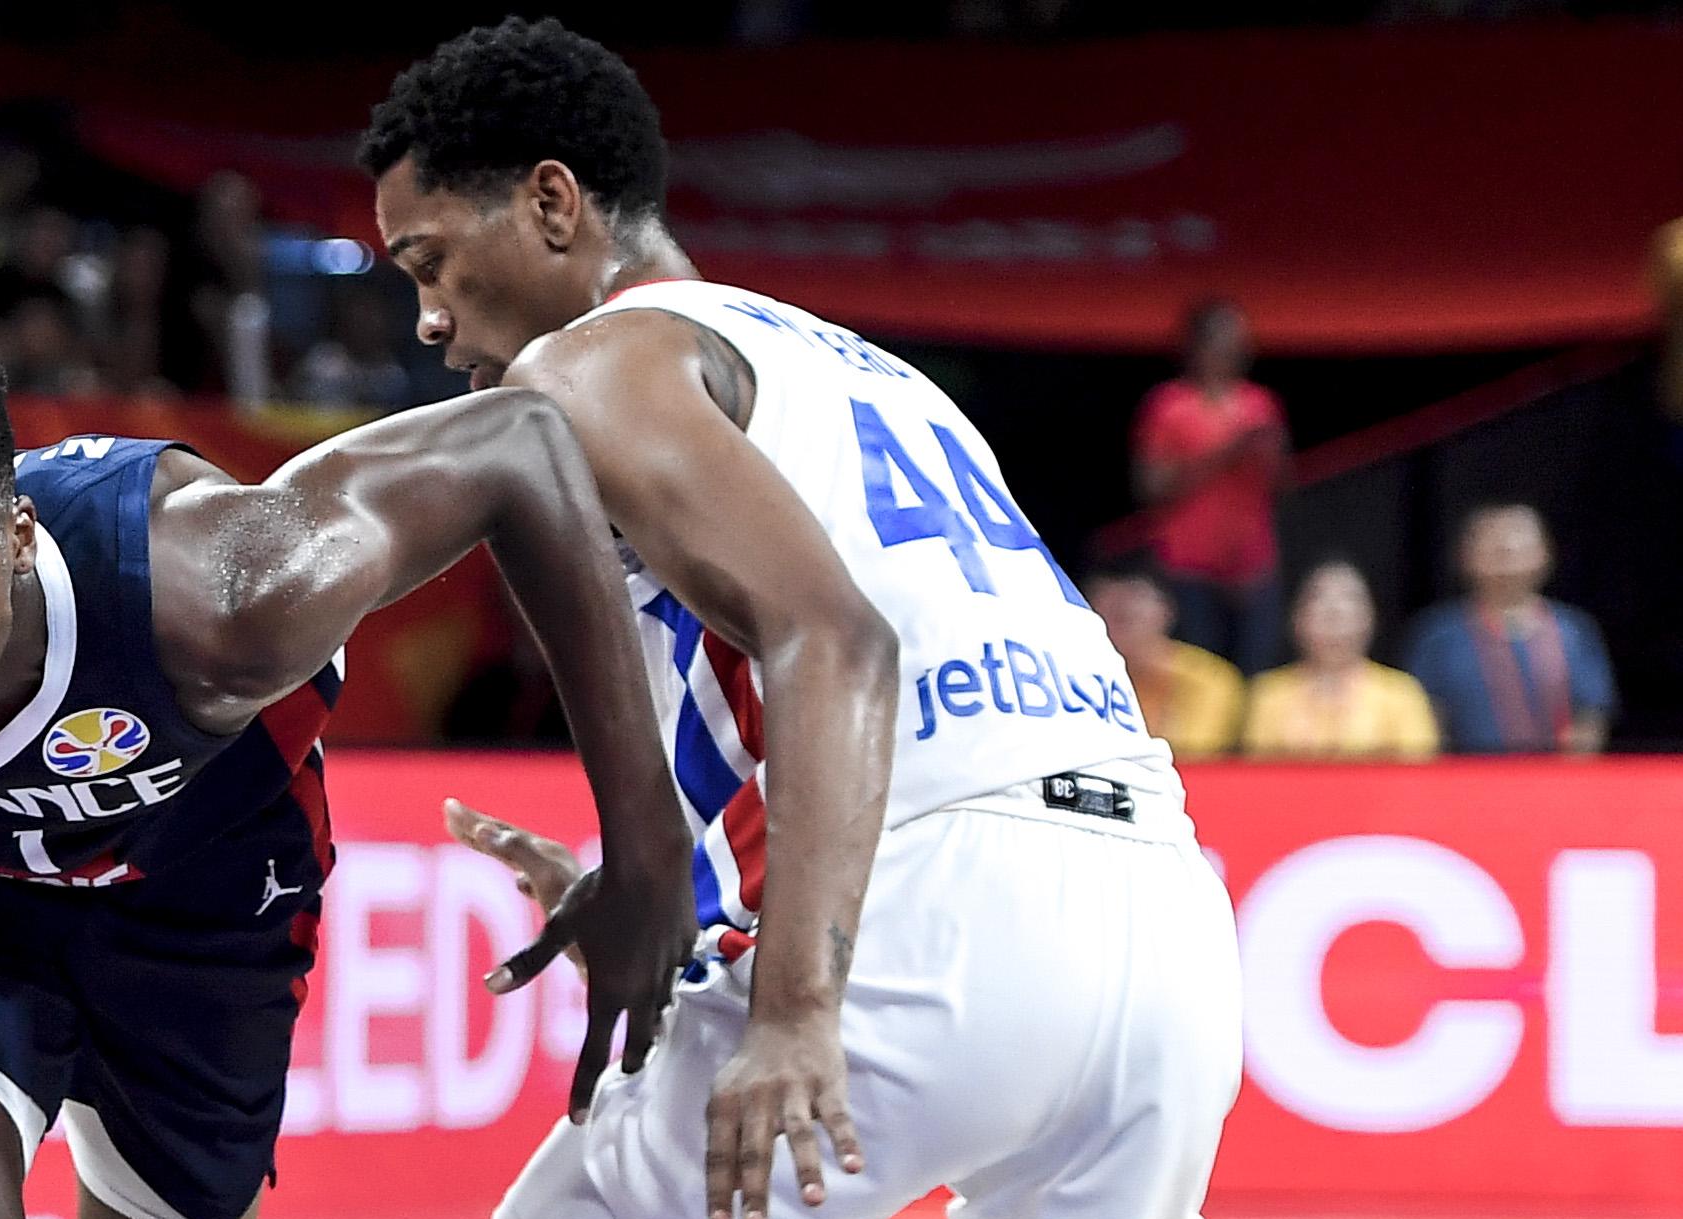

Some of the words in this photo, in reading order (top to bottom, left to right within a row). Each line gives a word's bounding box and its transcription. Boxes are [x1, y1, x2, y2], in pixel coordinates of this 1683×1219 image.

[849, 396, 1093, 611] 44
[273, 840, 543, 1136] ED
[1200, 832, 1683, 1134] CL
